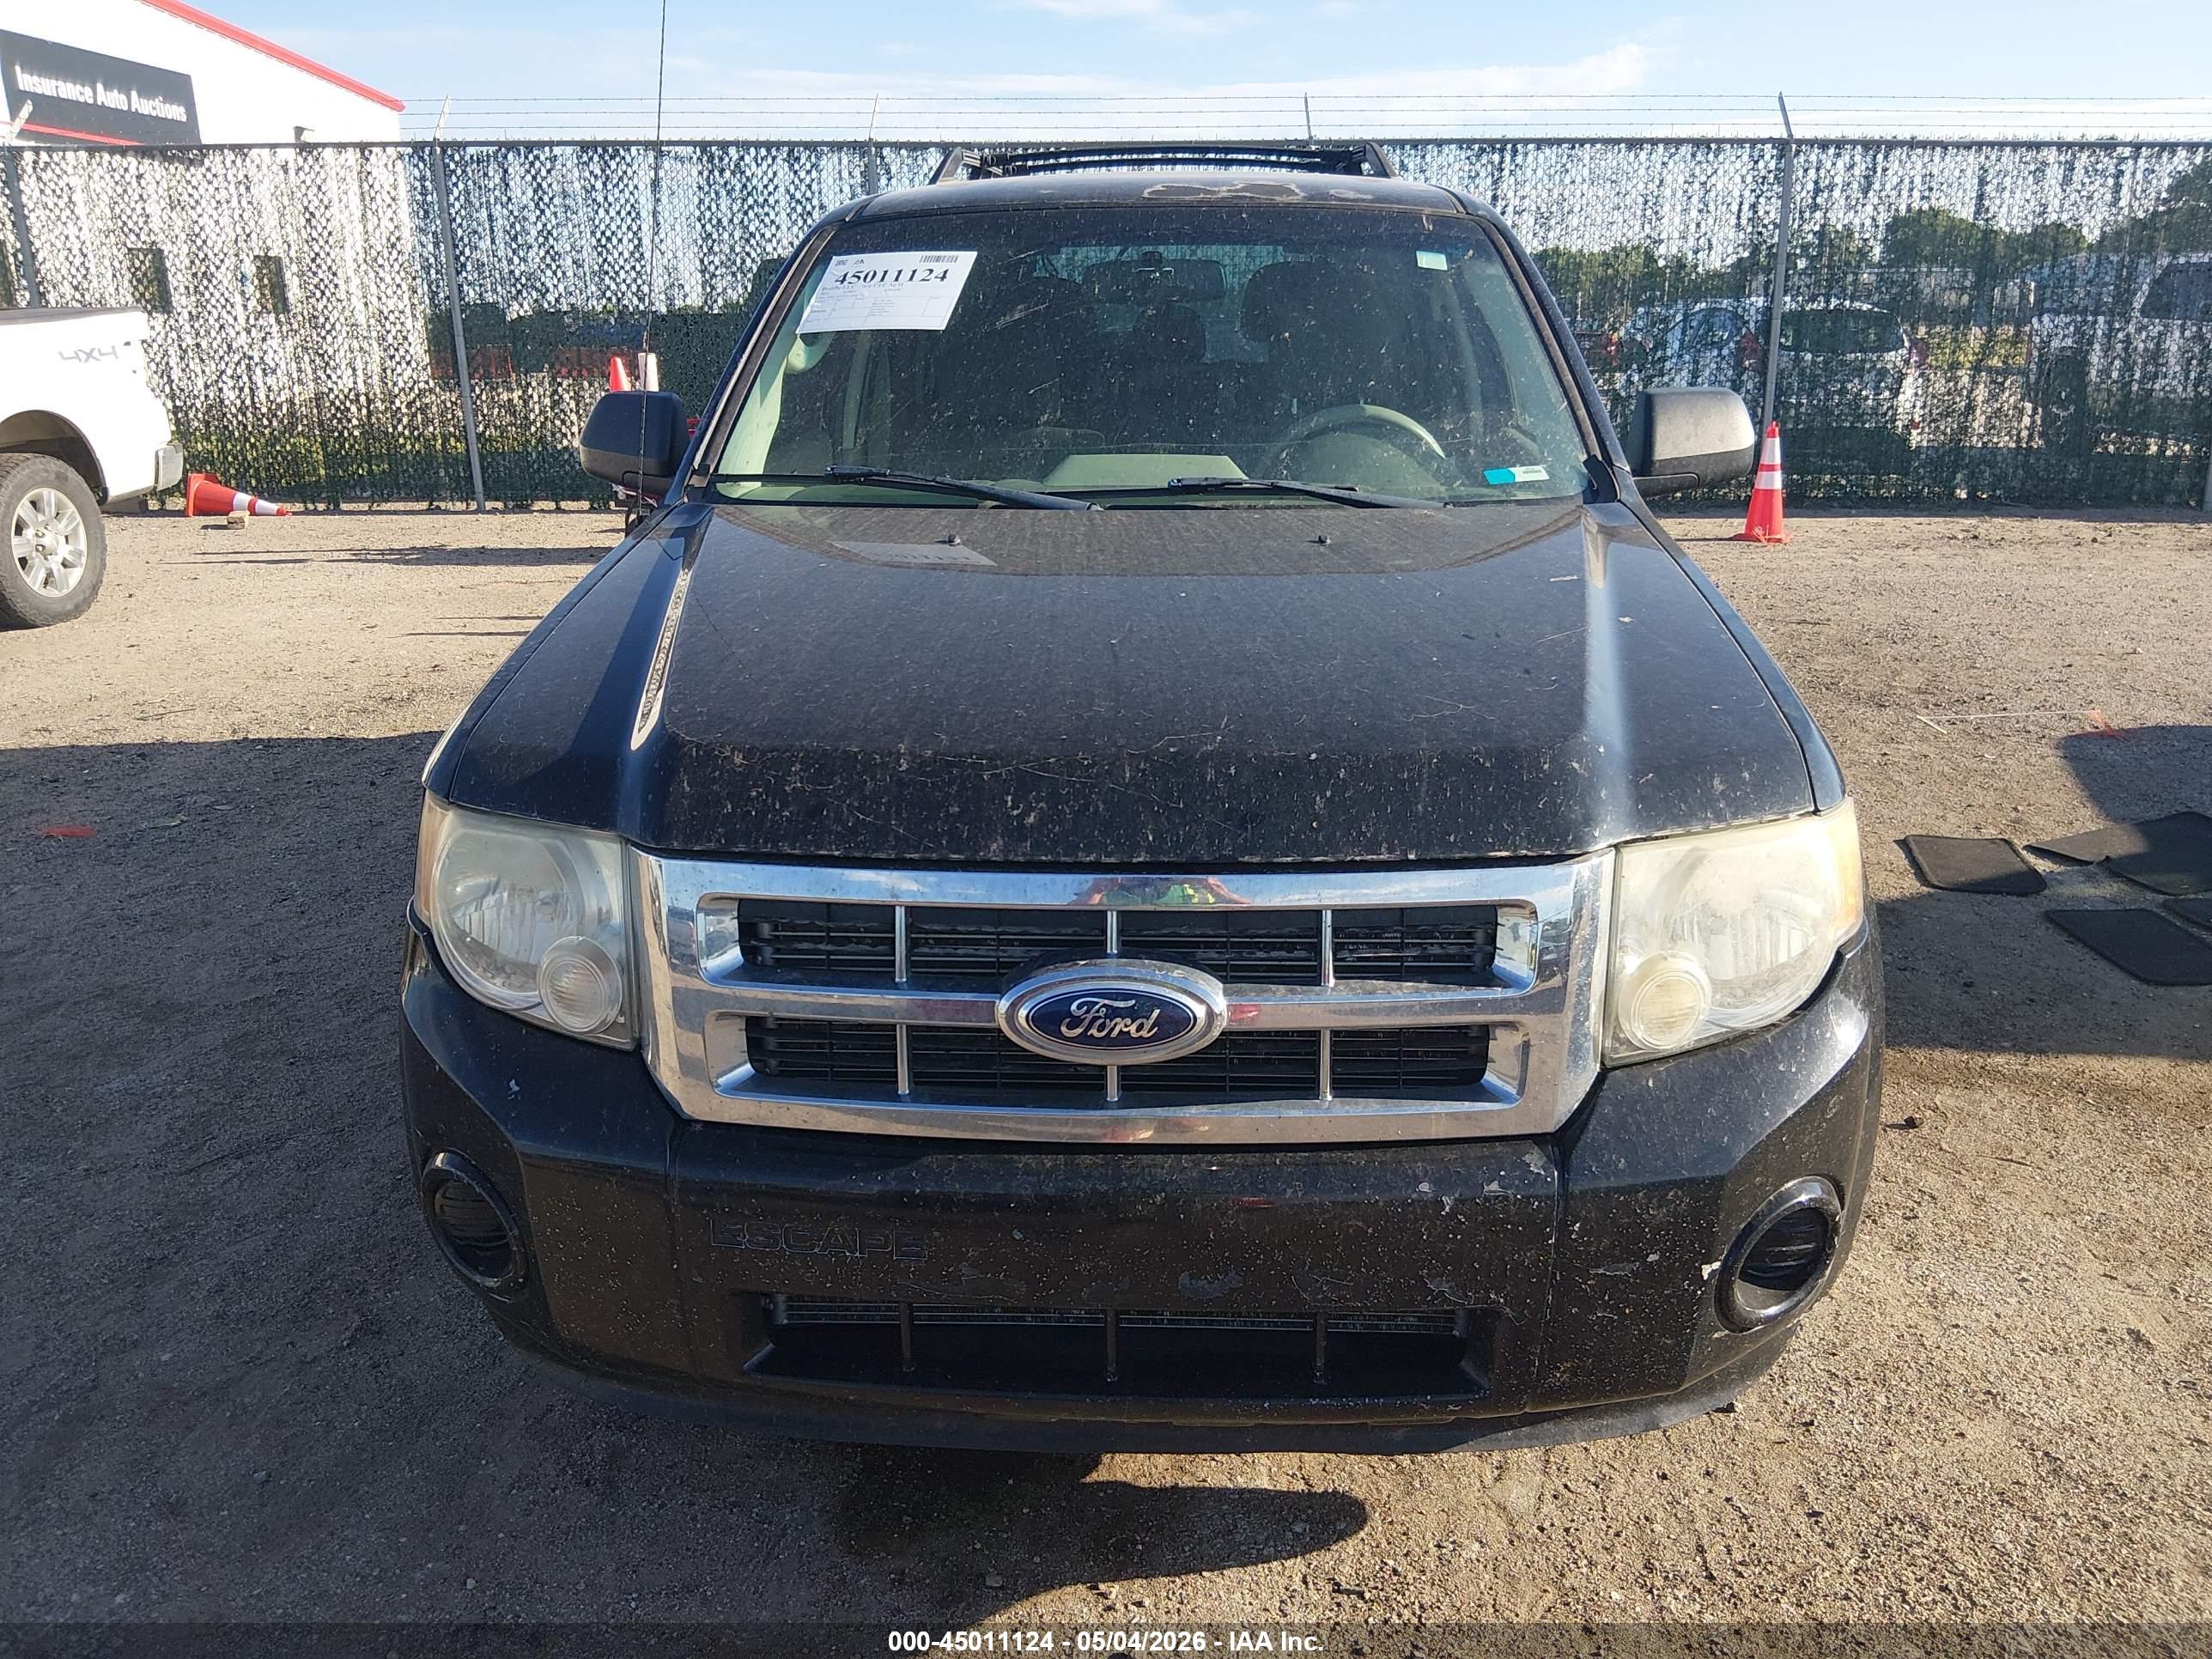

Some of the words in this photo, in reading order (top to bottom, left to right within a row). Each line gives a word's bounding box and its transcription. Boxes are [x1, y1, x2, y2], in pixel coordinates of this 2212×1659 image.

[15, 64, 94, 104] Insurance
[96, 82, 128, 111] Auto
[131, 90, 187, 122] Auctions
[834, 267, 950, 285] 45011124
[1060, 997, 1161, 1039] Ford
[709, 1218, 928, 1261] ESCAPE
